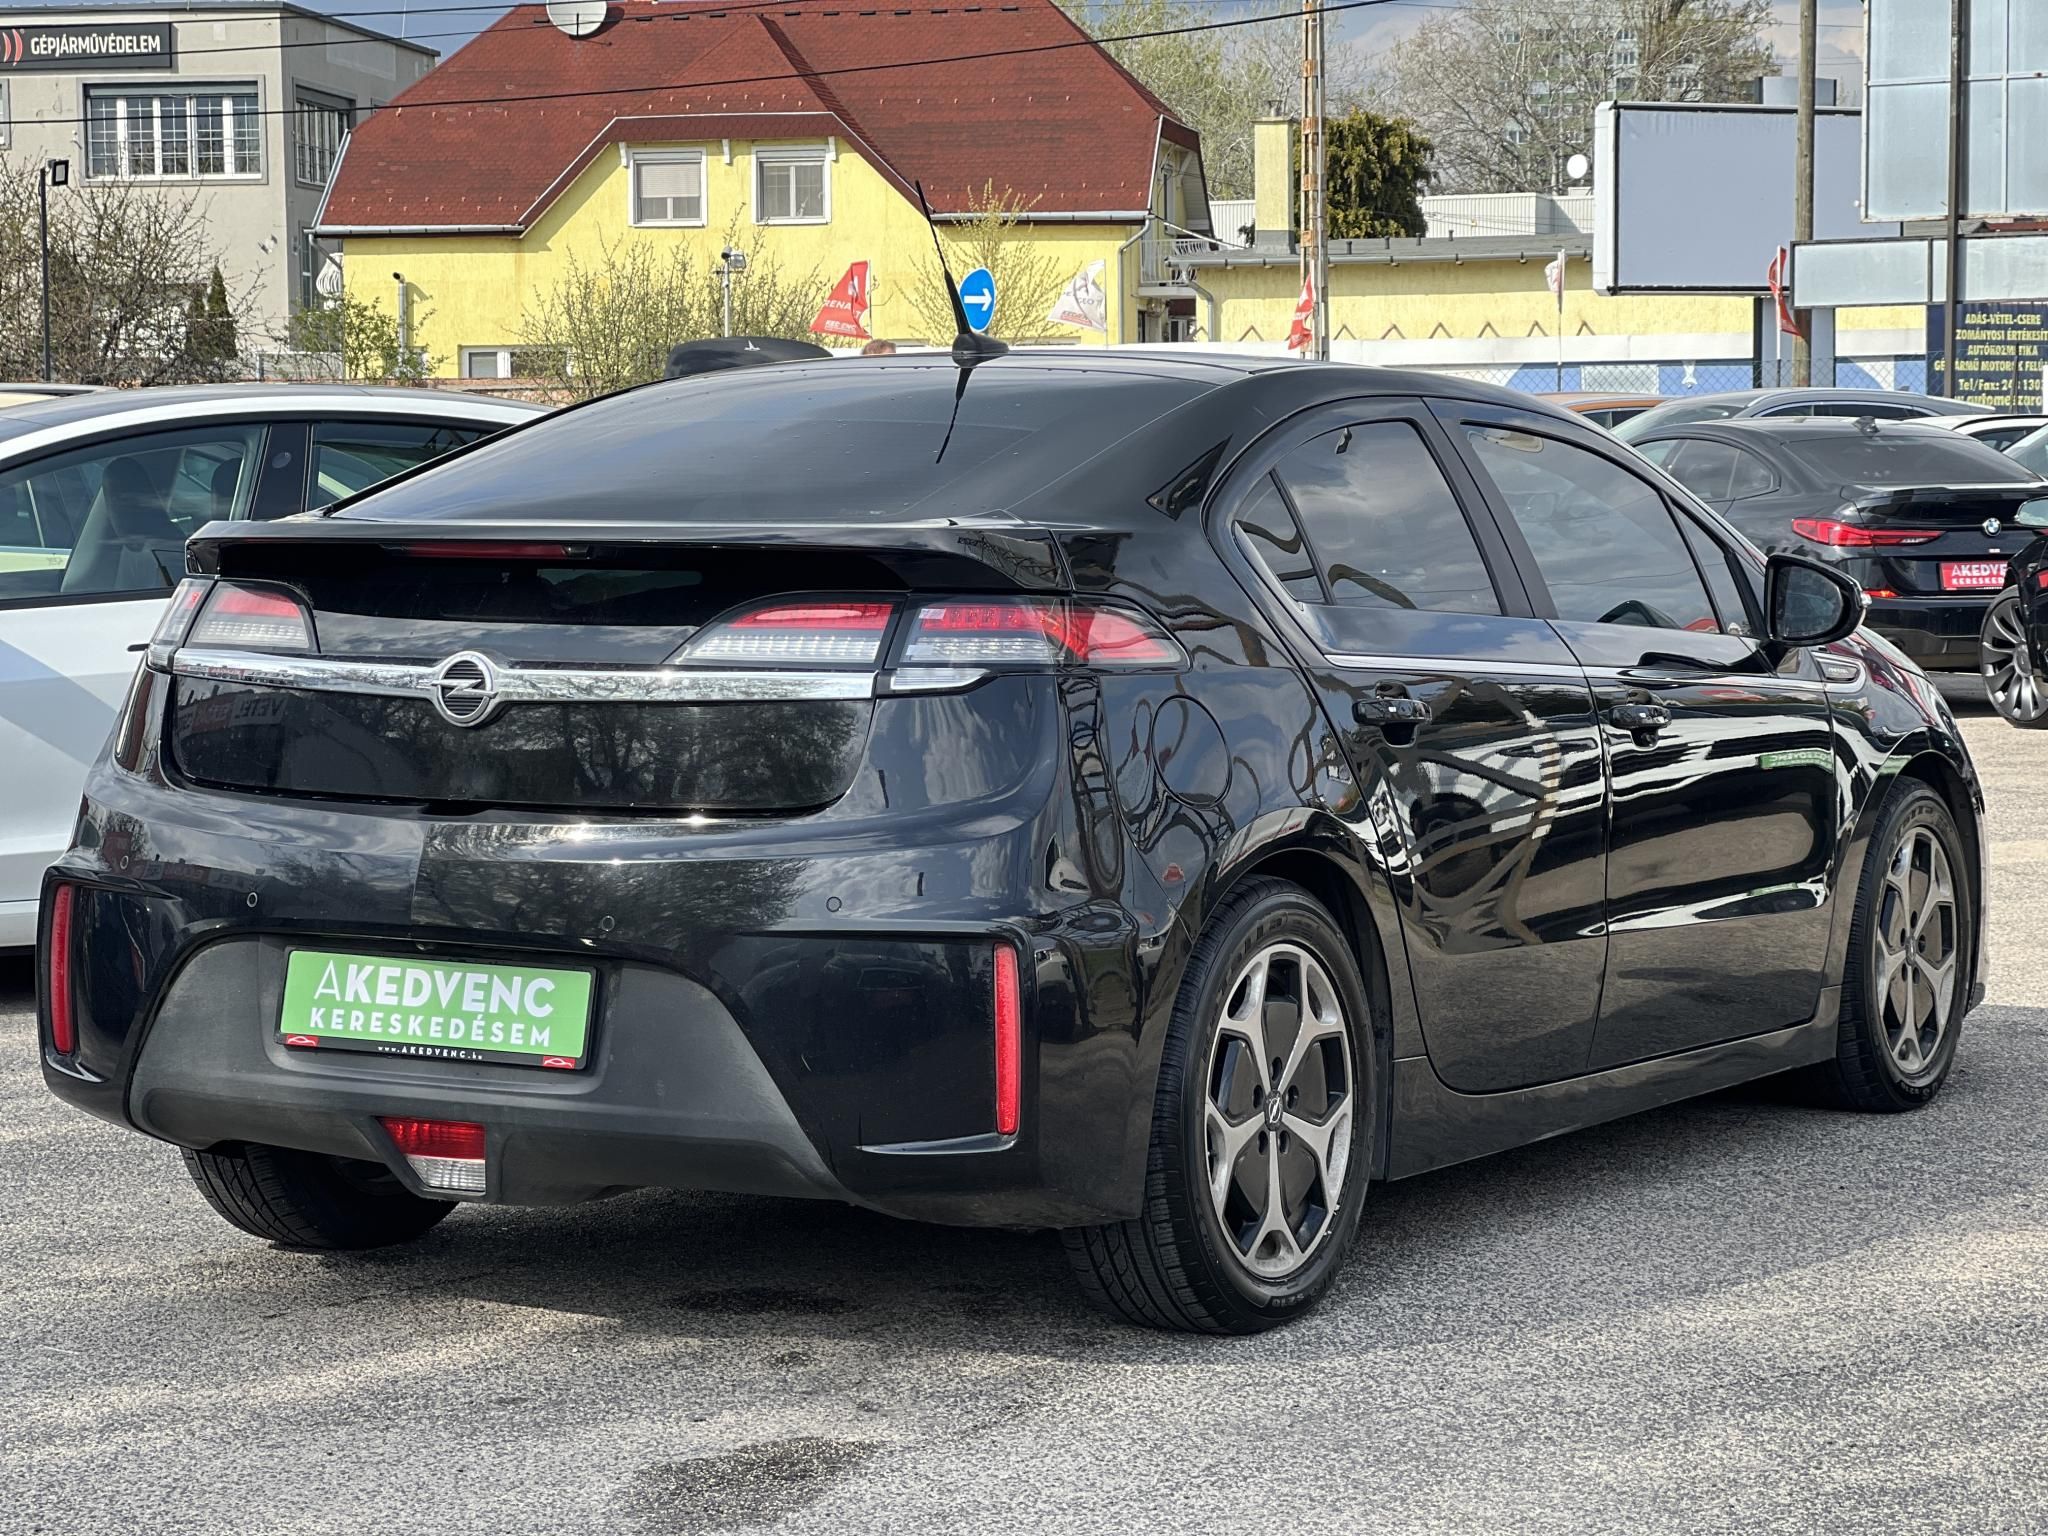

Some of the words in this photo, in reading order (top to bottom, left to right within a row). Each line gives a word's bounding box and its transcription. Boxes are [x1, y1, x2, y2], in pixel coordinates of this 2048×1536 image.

[30, 33, 161, 57] GÉPJÁRMŰVÉDELEM
[313, 959, 556, 1018] AKEDVENC
[309, 1007, 551, 1048] KERESKEDÉSEM
